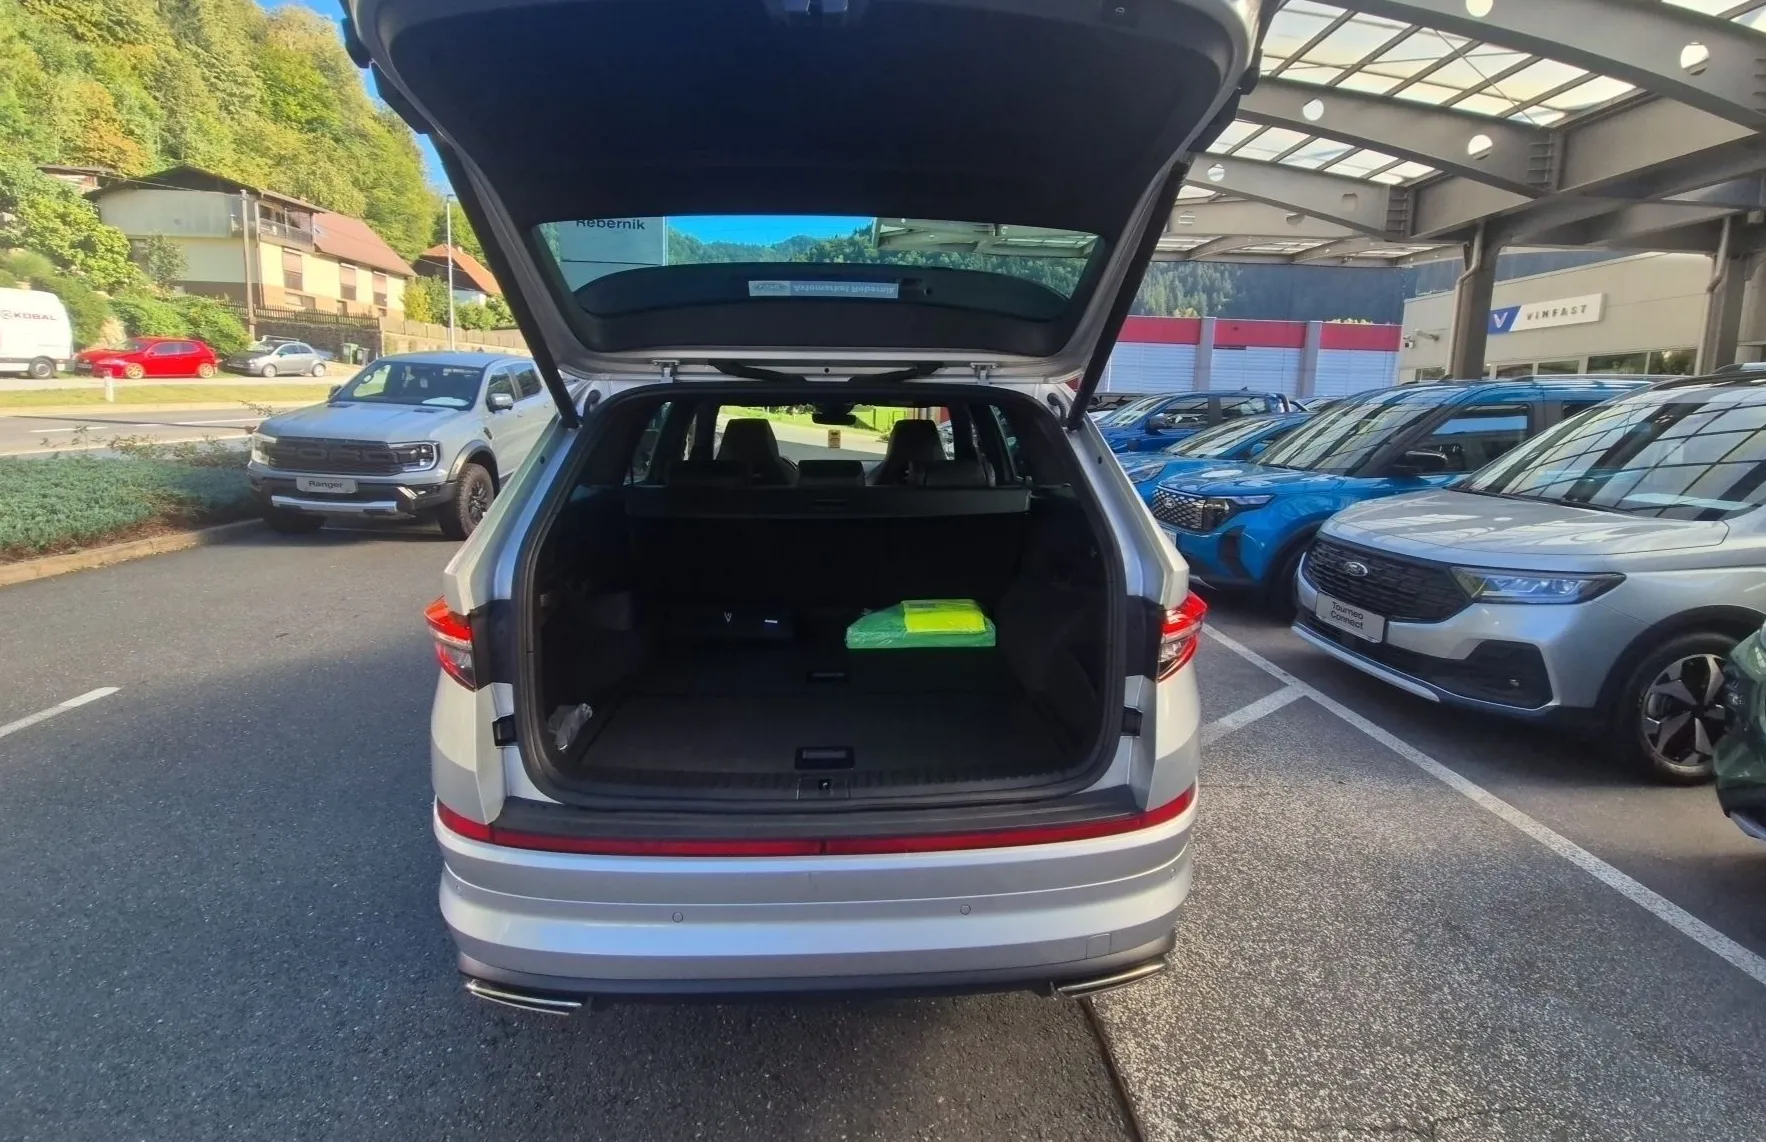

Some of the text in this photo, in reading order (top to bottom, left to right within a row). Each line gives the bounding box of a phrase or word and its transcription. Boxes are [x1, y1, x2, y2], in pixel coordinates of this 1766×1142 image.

[576, 218, 645, 230] Rebernik
[13, 311, 57, 321] KOBAL
[1526, 304, 1588, 321] VINFAST
[308, 480, 344, 489] Ranger
[1332, 601, 1364, 620] Tourneo
[1330, 610, 1364, 630] Connect
